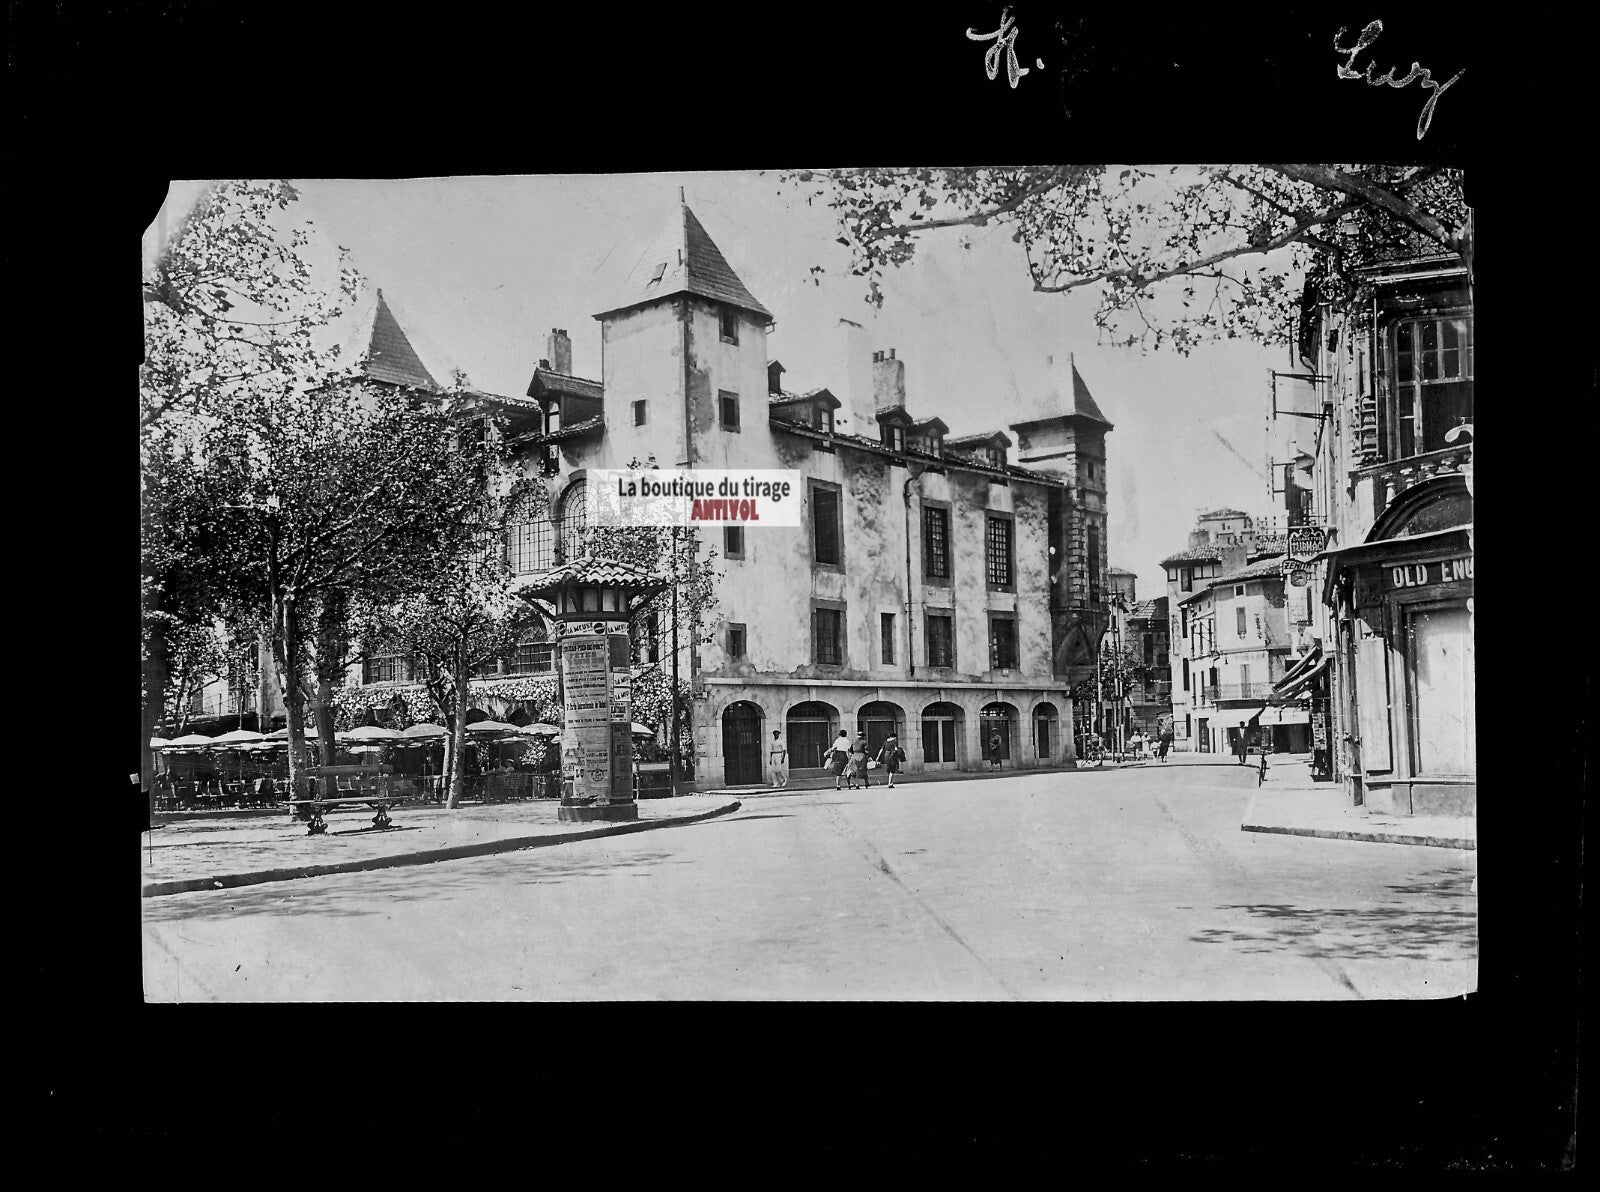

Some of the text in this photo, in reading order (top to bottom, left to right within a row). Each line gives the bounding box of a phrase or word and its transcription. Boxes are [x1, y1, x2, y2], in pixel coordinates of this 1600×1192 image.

[1291, 539, 1322, 552] TURMAC
[1283, 561, 1312, 570] ZENITH
[1392, 564, 1428, 588] OLD
